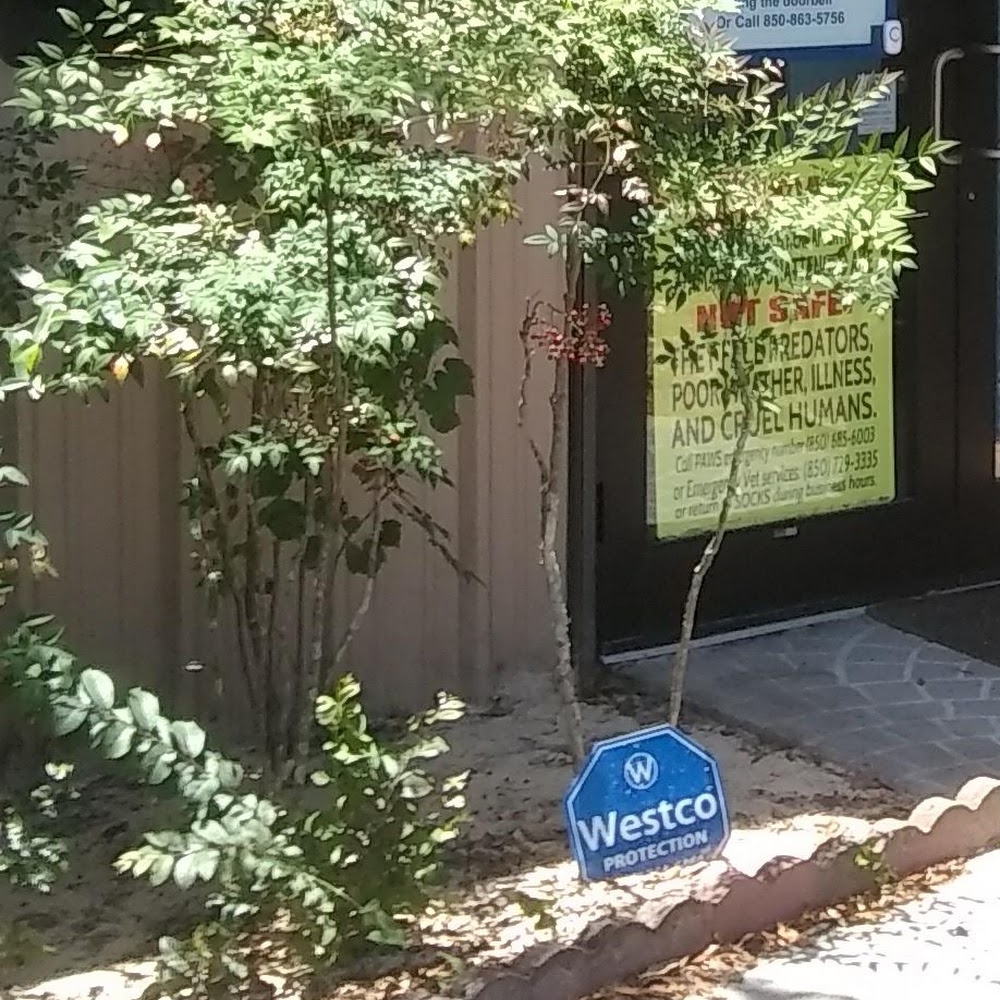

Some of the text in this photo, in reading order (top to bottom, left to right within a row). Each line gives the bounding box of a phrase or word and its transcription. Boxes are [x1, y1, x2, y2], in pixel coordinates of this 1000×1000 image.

[716, 12, 845, 29] Or Call 850-863-5756
[671, 356, 876, 412] POOR ATHER, ILLNESS,
[671, 414, 715, 449] AND
[789, 391, 878, 431] HUMANS.
[673, 485, 685, 501] or
[577, 793, 718, 851] Westco
[603, 829, 709, 873] PROTECTION
